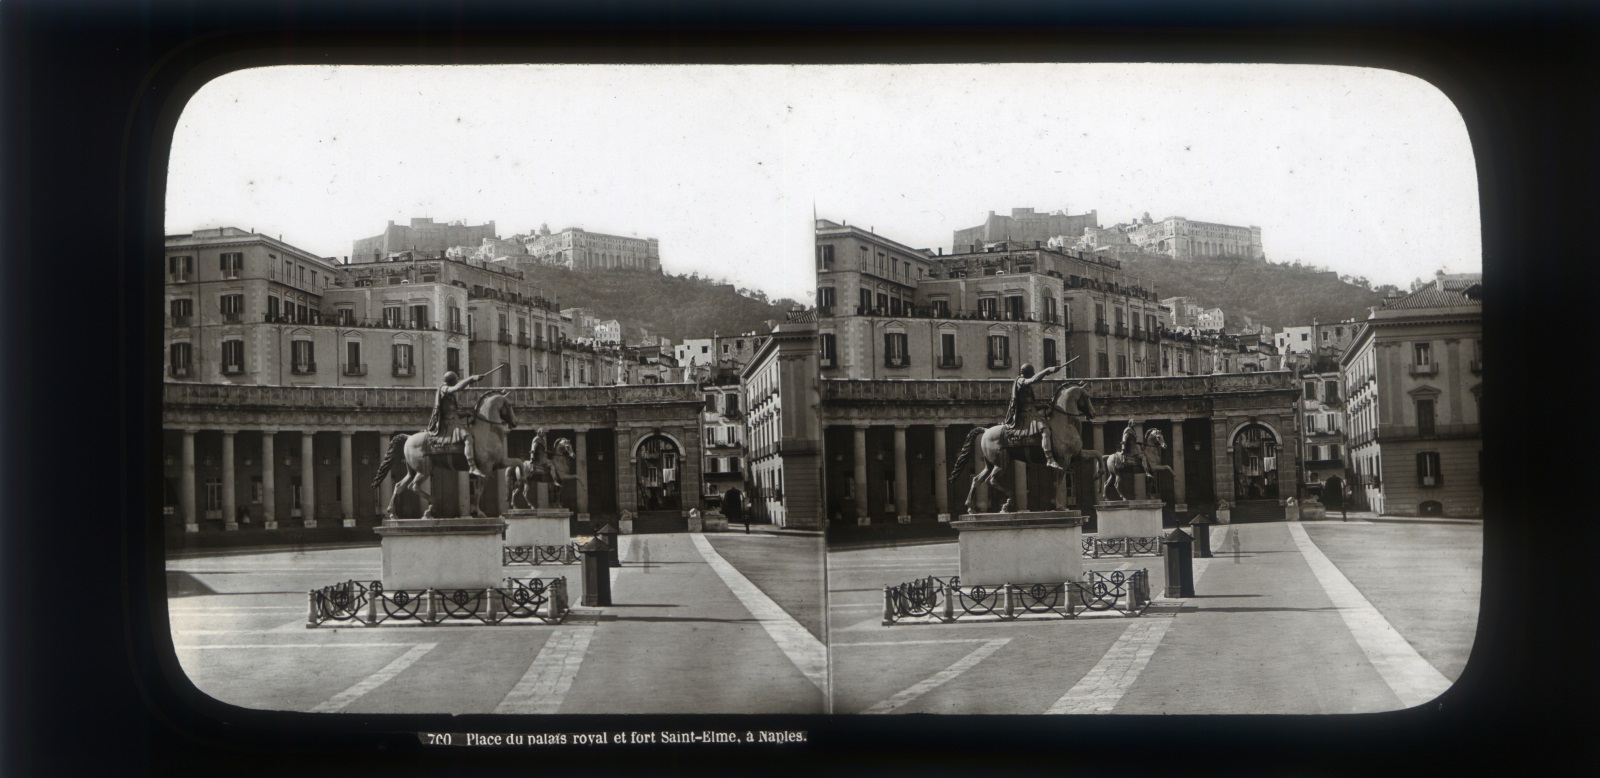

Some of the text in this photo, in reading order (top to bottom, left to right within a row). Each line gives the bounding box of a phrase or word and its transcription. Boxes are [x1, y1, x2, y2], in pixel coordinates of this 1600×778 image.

[467, 733, 502, 746] Place
[506, 733, 523, 745] du
[527, 733, 567, 747] palais
[573, 732, 608, 746] royal
[613, 733, 627, 744] et
[631, 731, 656, 744] fort
[661, 731, 742, 745] Saint-Elme,
[758, 730, 807, 745] Naples.
